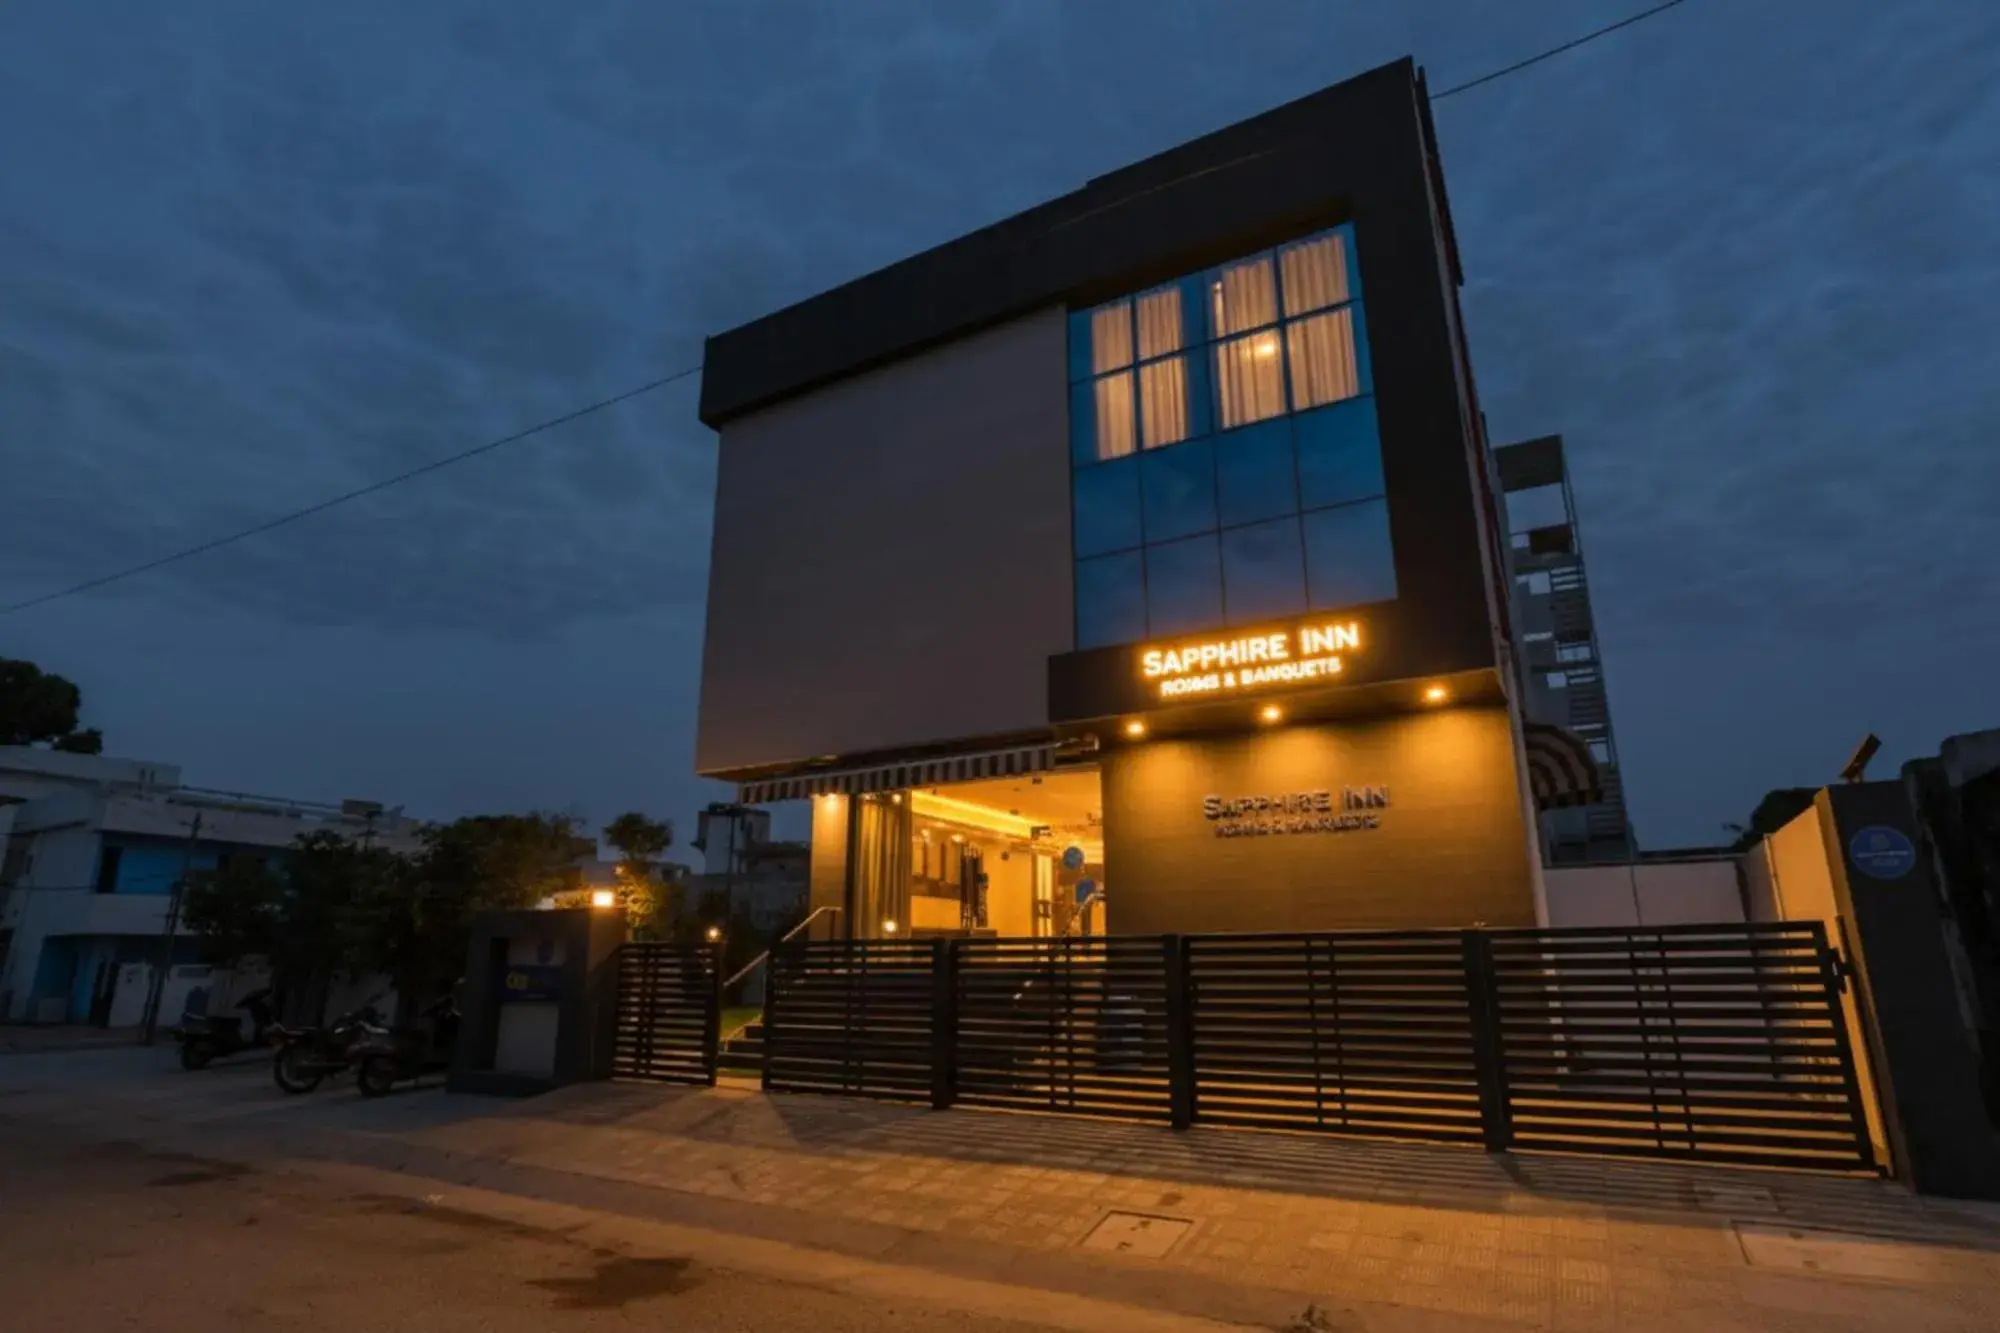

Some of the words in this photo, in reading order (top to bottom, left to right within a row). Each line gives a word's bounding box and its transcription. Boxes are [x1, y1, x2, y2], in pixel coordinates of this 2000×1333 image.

[1143, 633, 1289, 677] SAPPHIRE
[1300, 622, 1360, 655] INN
[1240, 656, 1341, 686] BANQUETS
